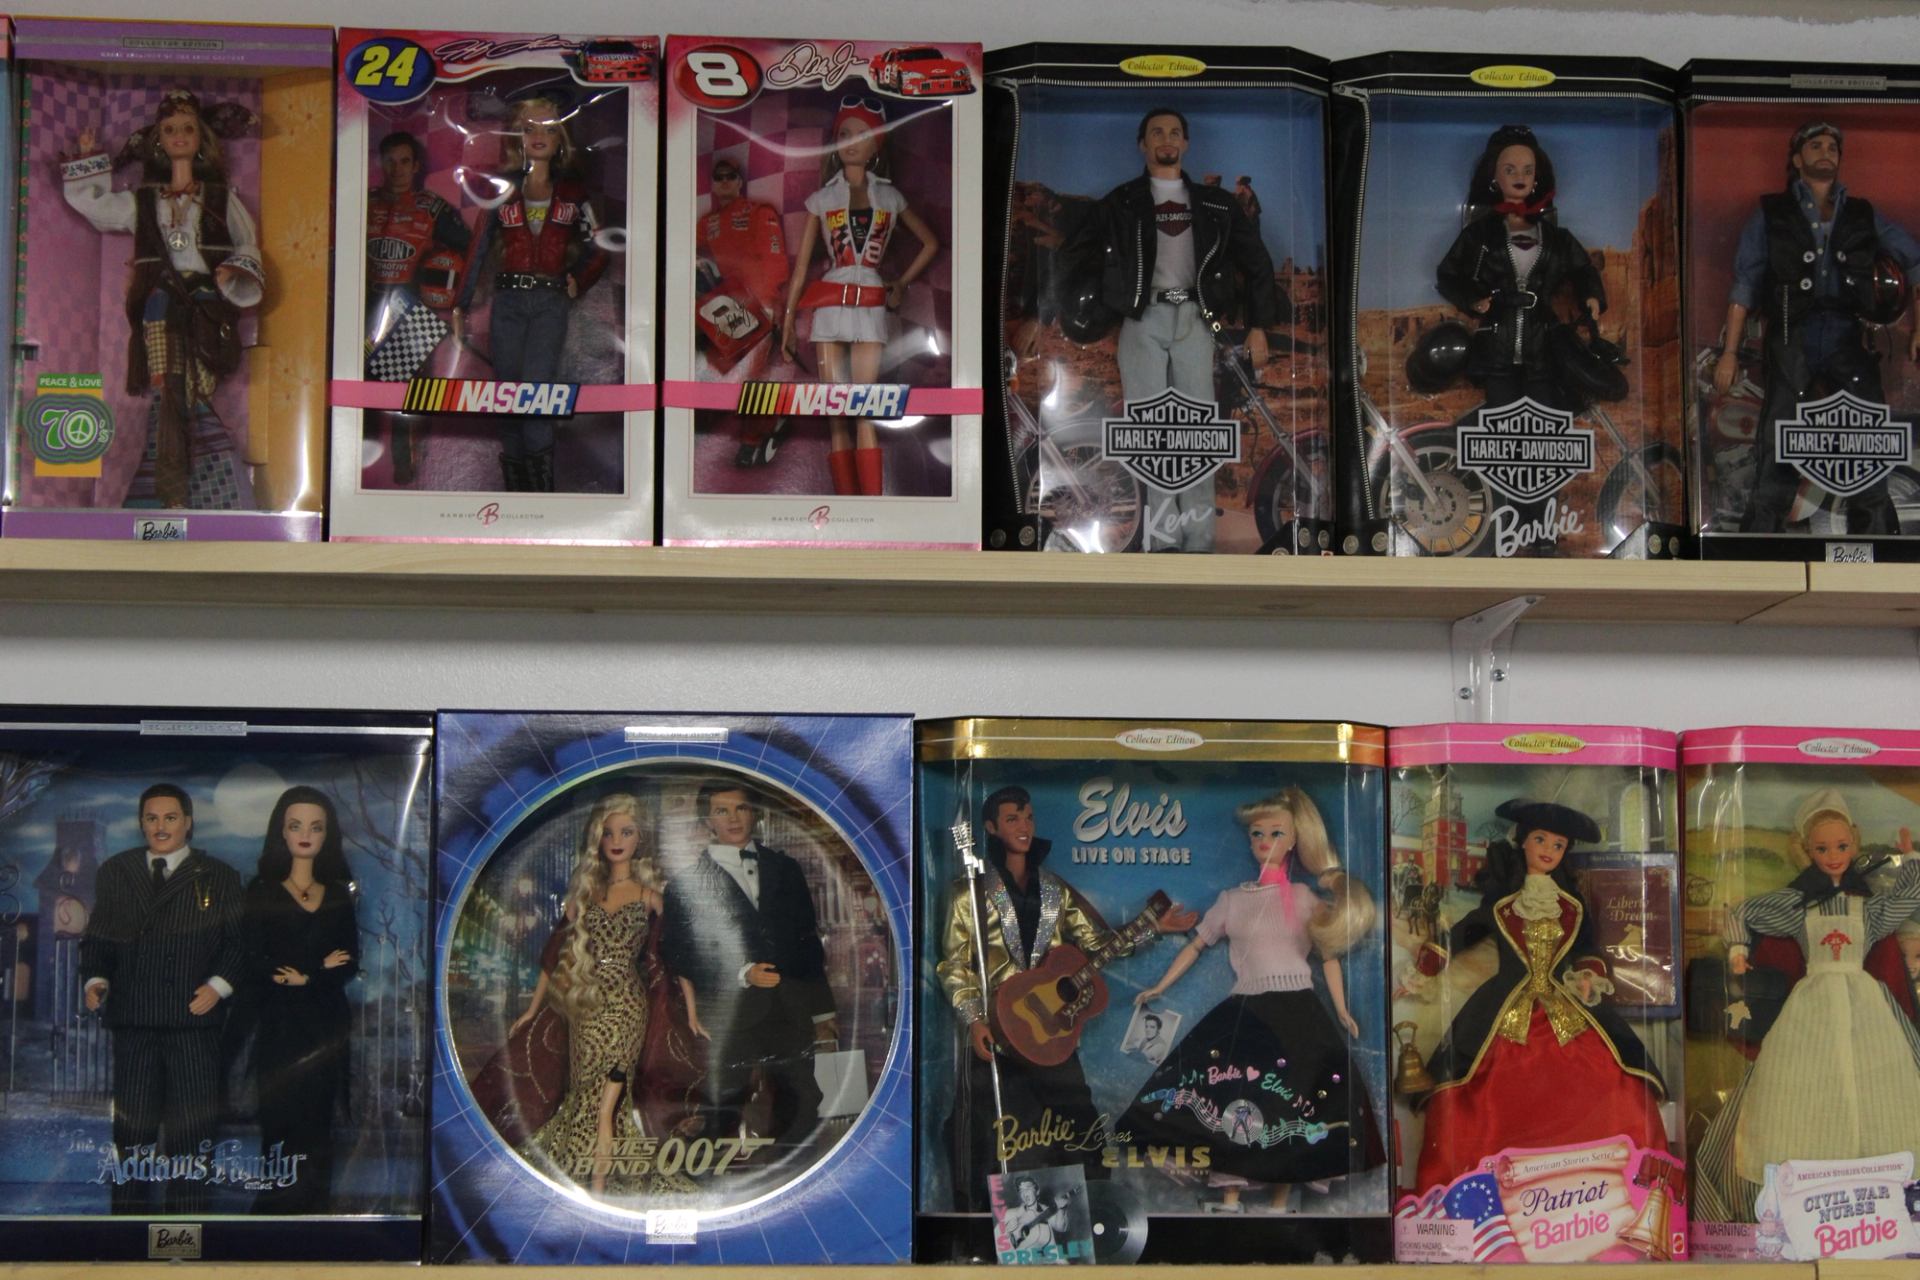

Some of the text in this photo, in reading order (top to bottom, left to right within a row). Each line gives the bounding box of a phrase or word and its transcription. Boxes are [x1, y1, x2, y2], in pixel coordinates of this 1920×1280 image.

[354, 46, 418, 87] 24
[687, 52, 749, 97] 8
[1127, 60, 1164, 70] Collector
[1478, 71, 1549, 82] Collector Edition
[40, 376, 102, 388] PEACE & LOVE
[456, 380, 571, 415] NASCAR
[790, 384, 902, 416] NASCAR
[1141, 401, 1201, 424] MOTOR
[1496, 410, 1557, 434] MOTOR
[1814, 405, 1875, 428] MOTOR
[1115, 429, 1229, 450] HARLEY-DAVIDSON
[1470, 439, 1583, 461] HARLEY-DAVIDSON
[1788, 433, 1900, 454] HARLEY-DAVIDSON
[1141, 456, 1202, 483] CYCLES
[1496, 466, 1557, 492] CYCLES
[1814, 459, 1875, 486] CYCLES
[142, 522, 180, 540] Barbie
[1143, 496, 1214, 549] Ken
[1490, 497, 1584, 557] Barbie
[1833, 546, 1867, 562] Barbie
[1125, 733, 1196, 745] Collector Edition
[1508, 736, 1580, 748] Collector Edition
[1805, 741, 1872, 754] Collector Edition
[1072, 776, 1188, 843] Elvis
[1072, 847, 1191, 865] LIVE ON STAGE
[1207, 1064, 1294, 1101] Barbie Elvis
[578, 1137, 659, 1156] JAMES
[993, 1107, 1133, 1162] Barbie Loves
[88, 1140, 208, 1186] Addams
[205, 1139, 300, 1188] Family
[573, 1156, 653, 1176] BOND
[656, 1137, 765, 1177] 007
[1101, 1145, 1211, 1169] ELVIS
[1523, 1151, 1616, 1174] American Stories Series
[1797, 1163, 1902, 1181] AMERICAN STORIES COLLECTION
[1521, 1180, 1609, 1217] Patriot
[1803, 1185, 1891, 1213] CIVIL WAR
[991, 1175, 1011, 1252] ELVIS
[1819, 1201, 1876, 1225] NURSE
[155, 1228, 194, 1249] Barbie
[1530, 1210, 1610, 1250] Barbie
[1814, 1215, 1898, 1258] Barbie
